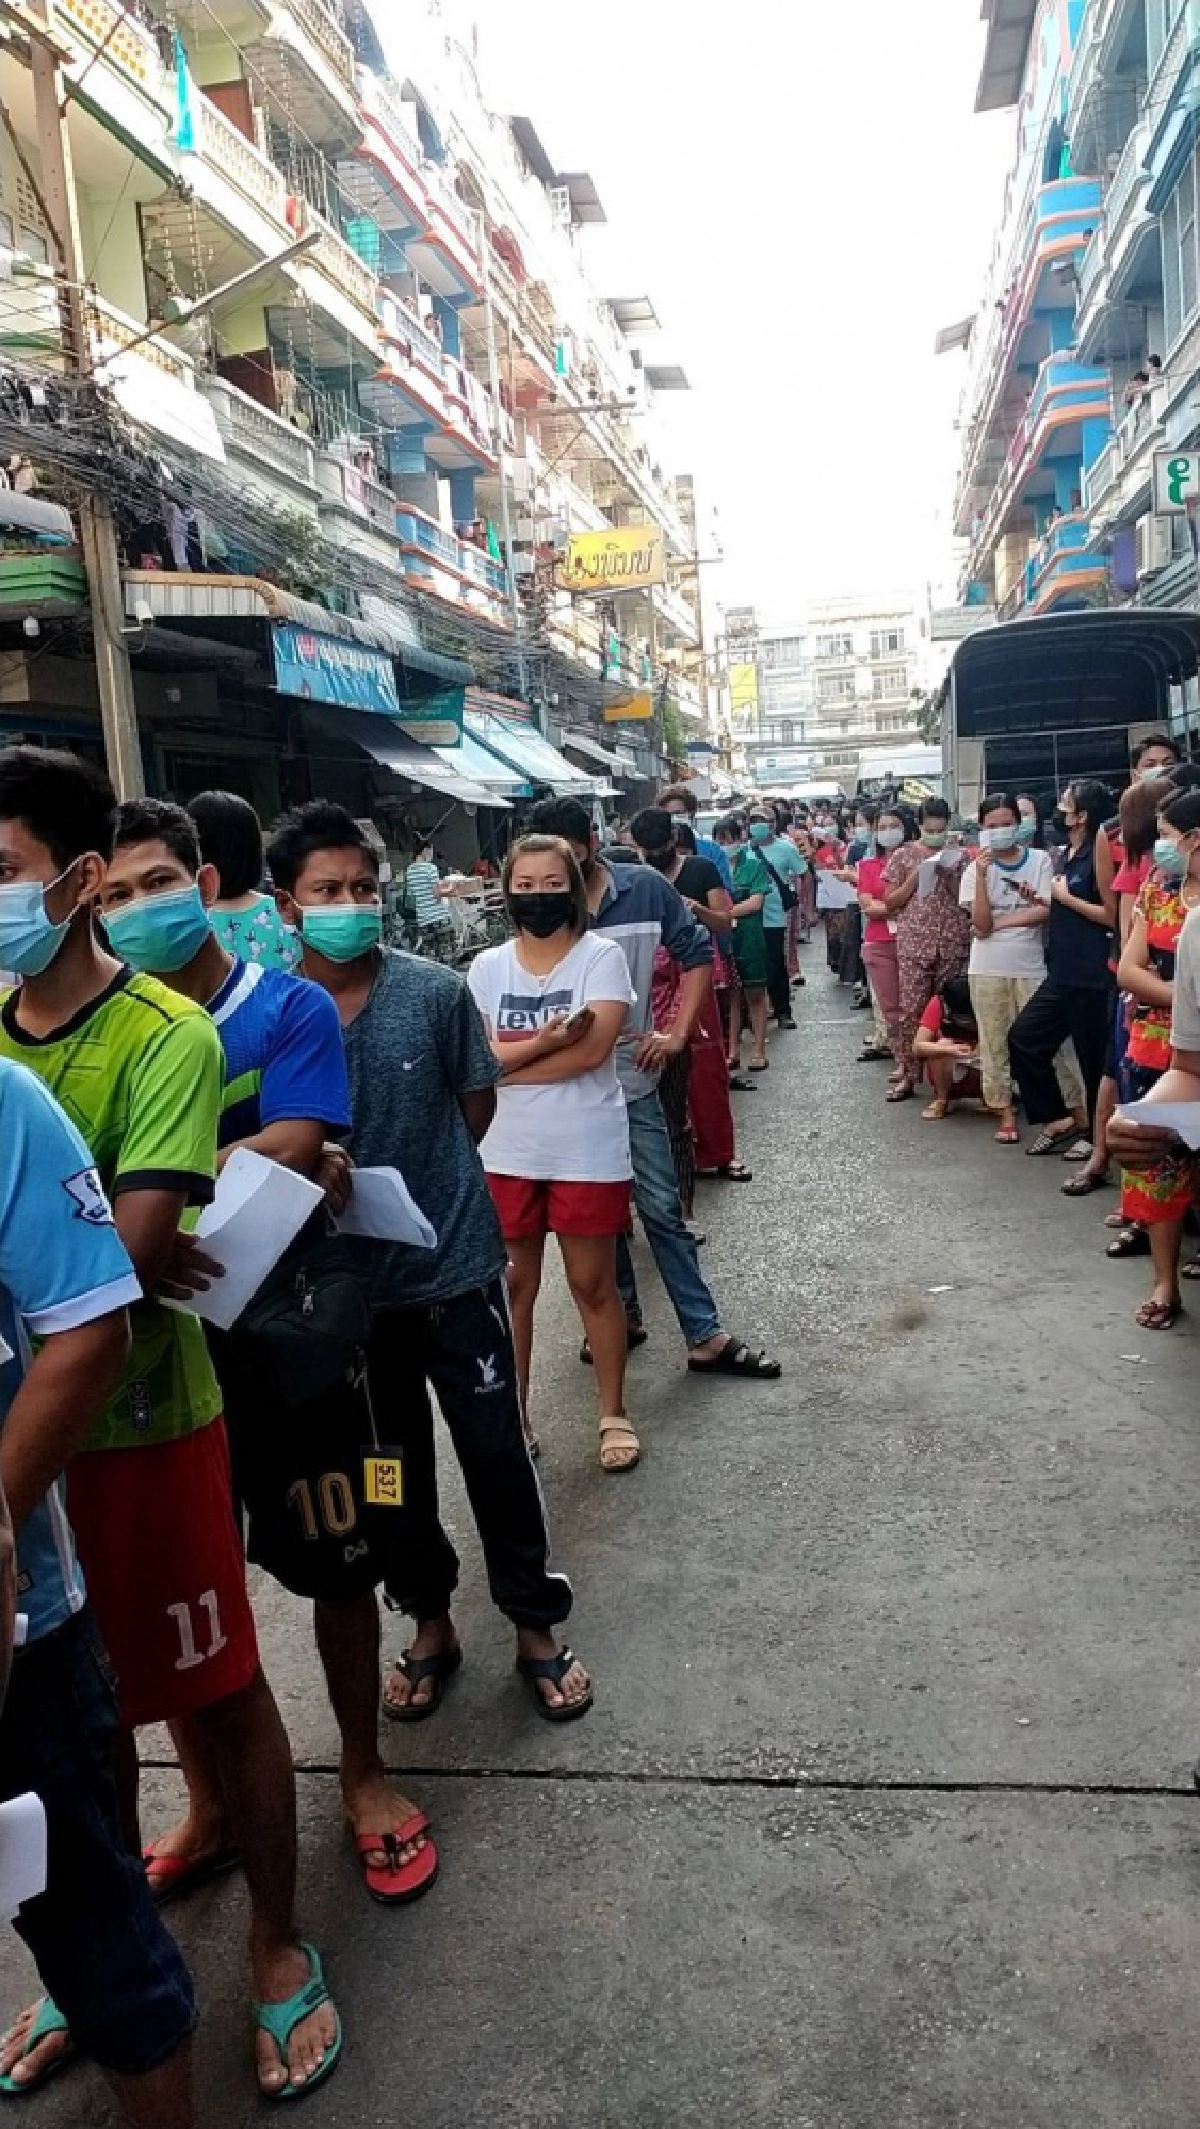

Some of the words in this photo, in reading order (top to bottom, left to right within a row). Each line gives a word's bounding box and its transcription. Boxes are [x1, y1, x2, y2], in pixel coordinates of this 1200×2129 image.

[286, 1472, 357, 1540] 10
[378, 1463, 397, 1499] 537
[166, 1588, 228, 1670] 11
